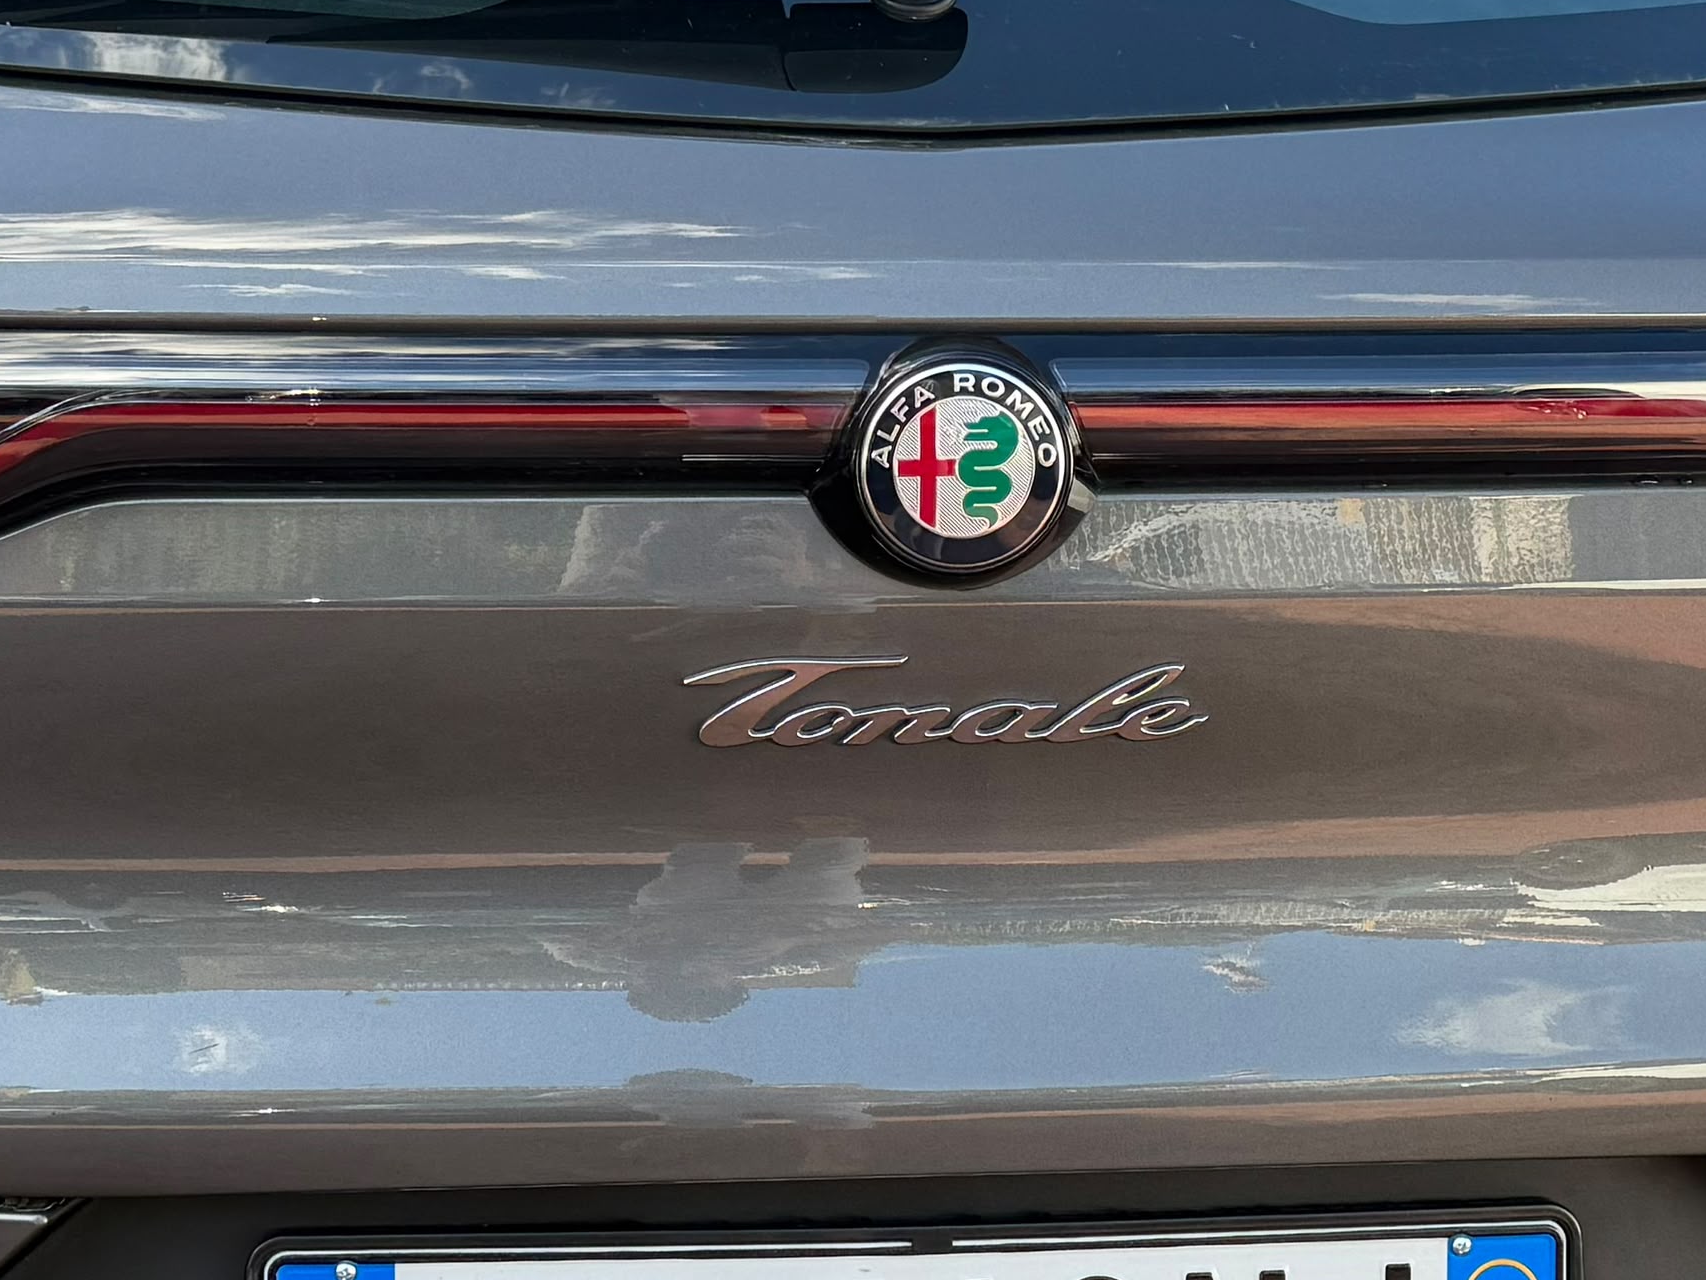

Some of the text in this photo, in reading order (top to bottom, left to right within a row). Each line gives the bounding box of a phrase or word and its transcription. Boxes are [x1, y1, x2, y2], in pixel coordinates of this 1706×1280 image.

[872, 372, 1058, 469] ALFA ROMEO
[682, 654, 1210, 749] Tonale
